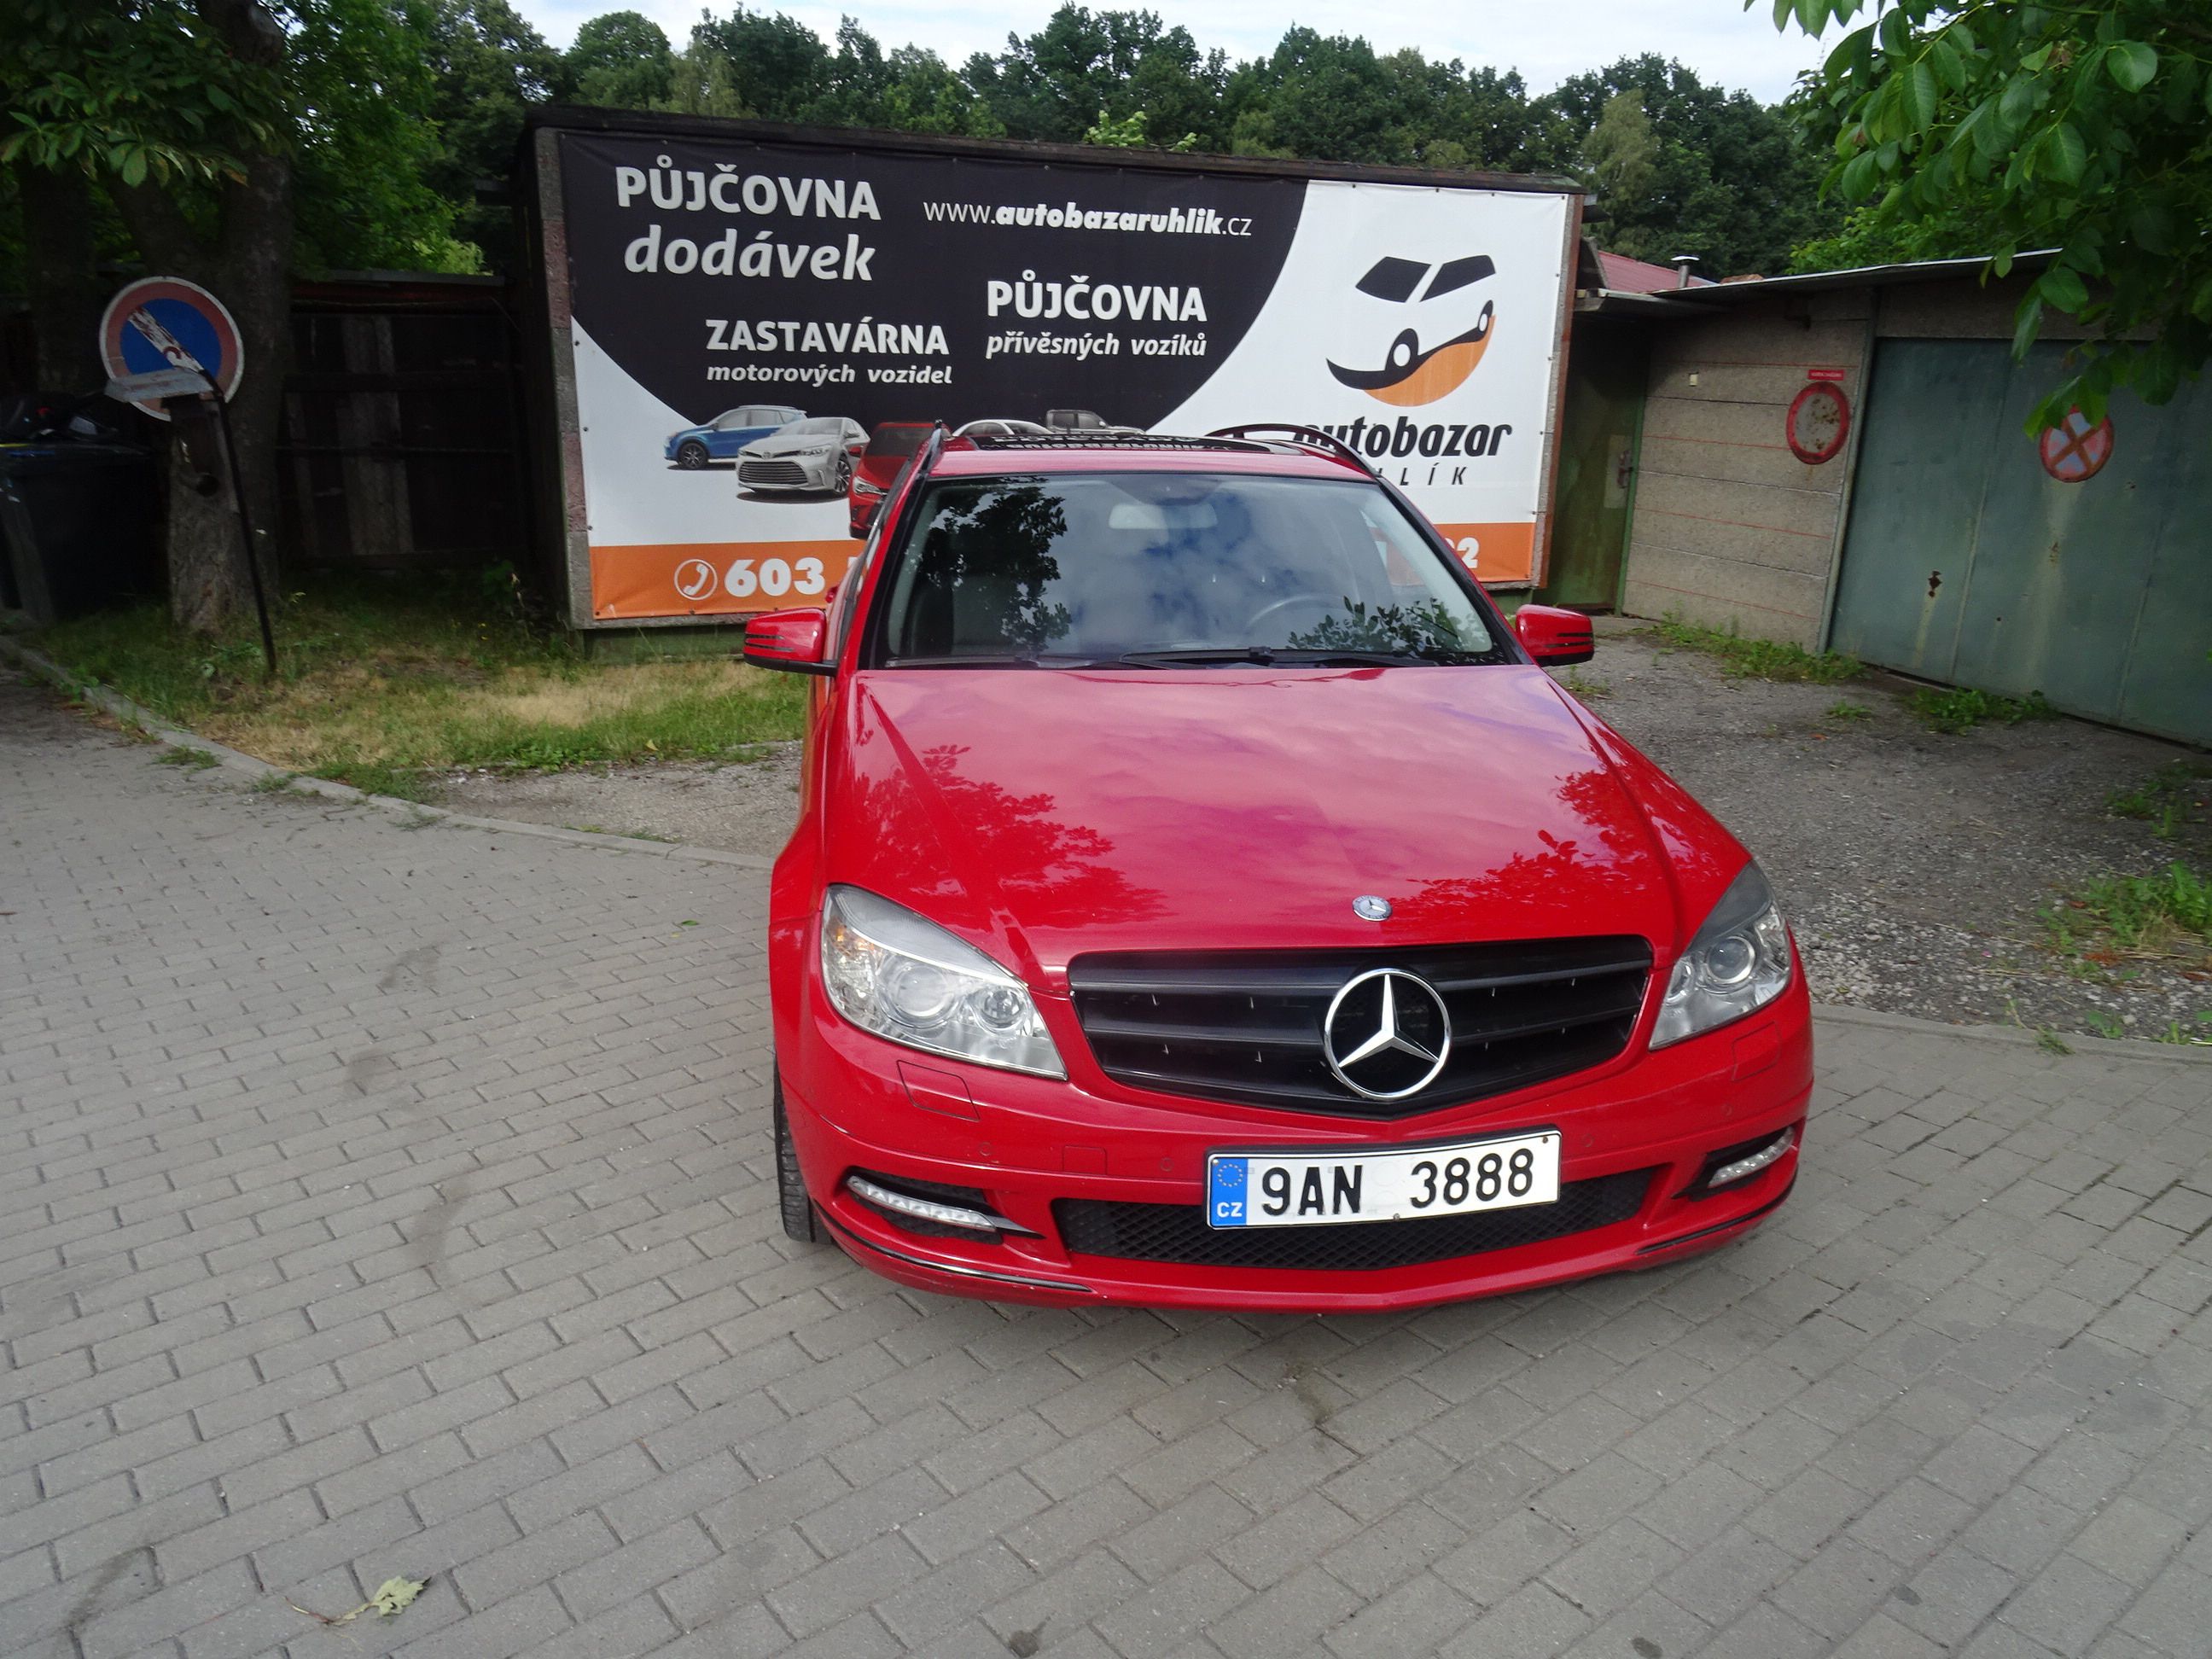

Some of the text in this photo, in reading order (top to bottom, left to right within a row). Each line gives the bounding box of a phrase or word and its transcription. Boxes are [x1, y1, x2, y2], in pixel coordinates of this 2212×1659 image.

[616, 154, 882, 220] PŮJČOVNA
[923, 201, 1253, 236] www.autobazaruhlik.cz
[624, 224, 876, 281] dodávek
[987, 269, 1208, 322] PŮJČOVNA
[706, 317, 950, 355] ZASTAVÁRNA
[985, 331, 1208, 361] přívěsných vozíků
[707, 364, 952, 387] motorových vozidel
[725, 556, 826, 597] 603
[1262, 1148, 1534, 1216] 9AN 3888
[1216, 1202, 1243, 1218] CZ
